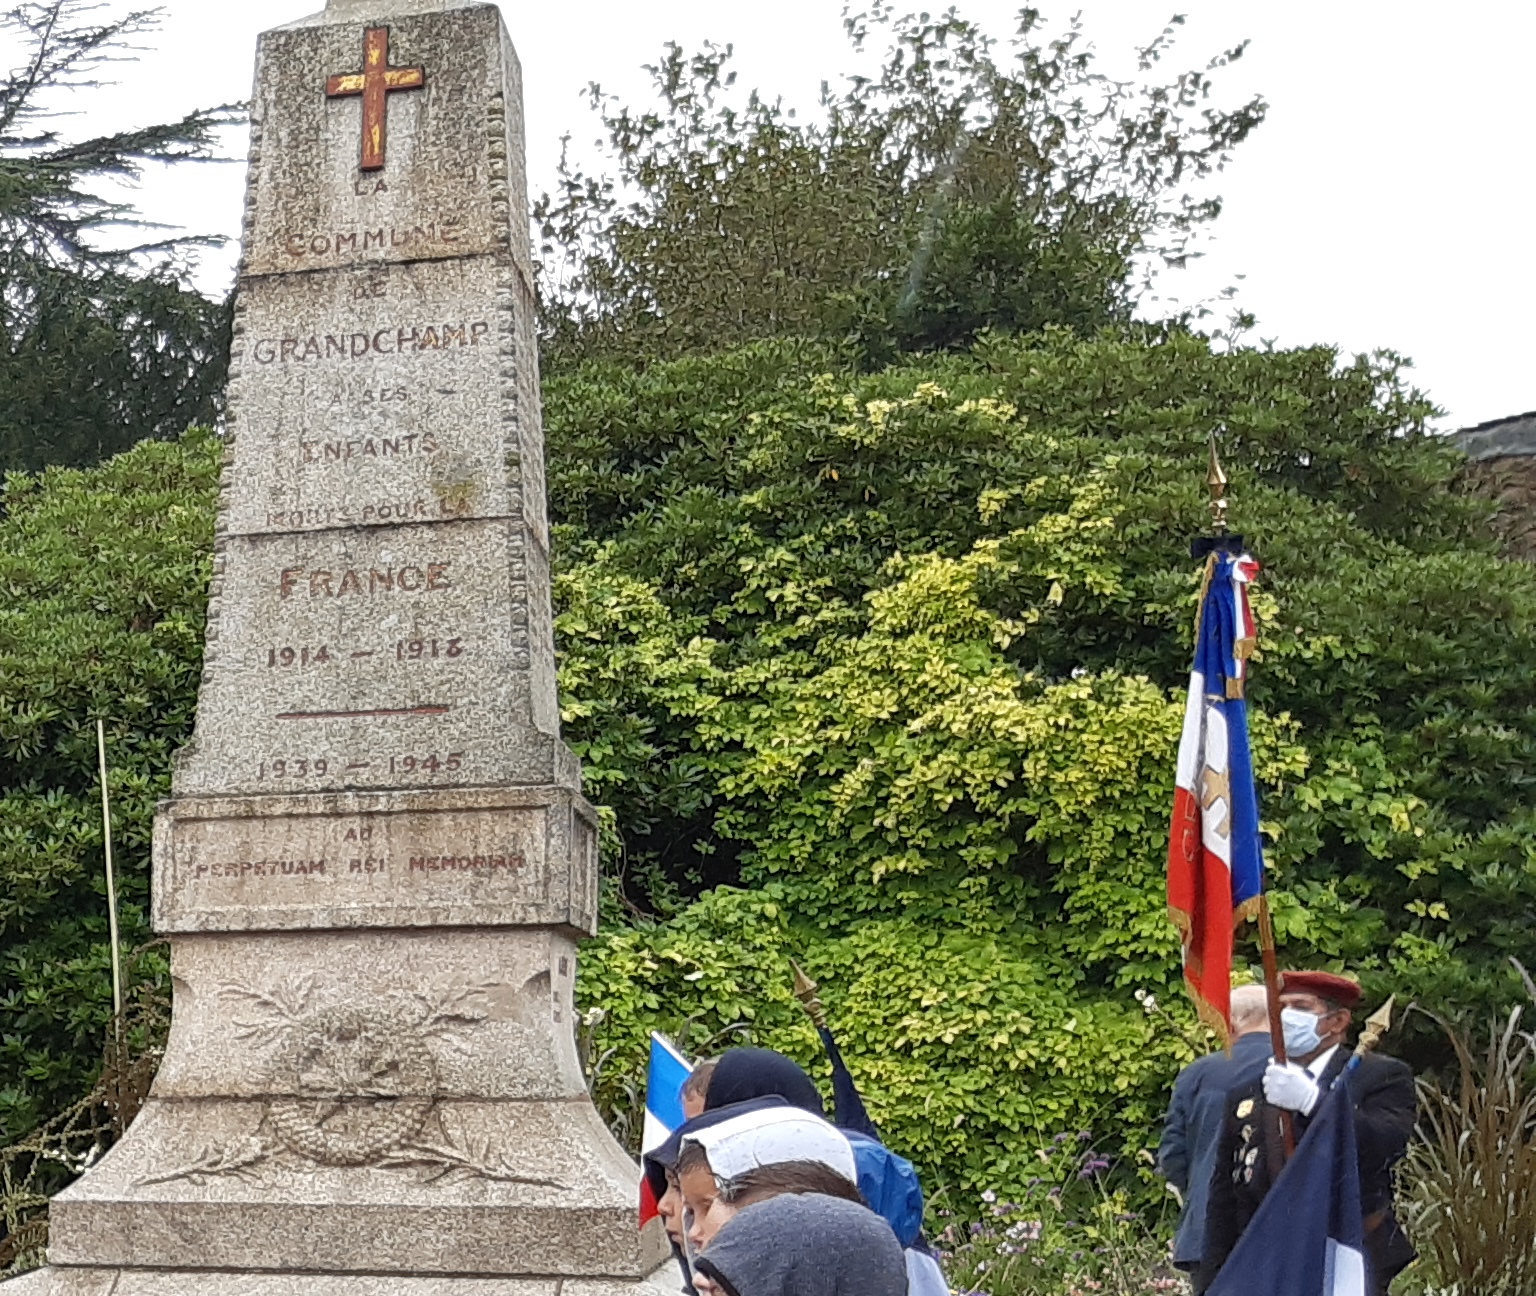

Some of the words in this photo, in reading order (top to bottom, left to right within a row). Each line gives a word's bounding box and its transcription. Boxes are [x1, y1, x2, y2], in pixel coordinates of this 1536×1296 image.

[354, 179, 388, 197] LA
[287, 223, 461, 257] COMMUNE
[353, 280, 387, 300] DE
[254, 321, 489, 365] GRANDCHAMP
[301, 431, 440, 463] ENFANTS
[362, 498, 427, 521] POUR
[280, 560, 452, 600] FRANCE
[267, 645, 330, 668] 1914
[257, 758, 329, 782] 1939
[387, 752, 462, 774] 1945
[195, 859, 327, 880] PERPETUAM
[349, 858, 386, 875] REI
